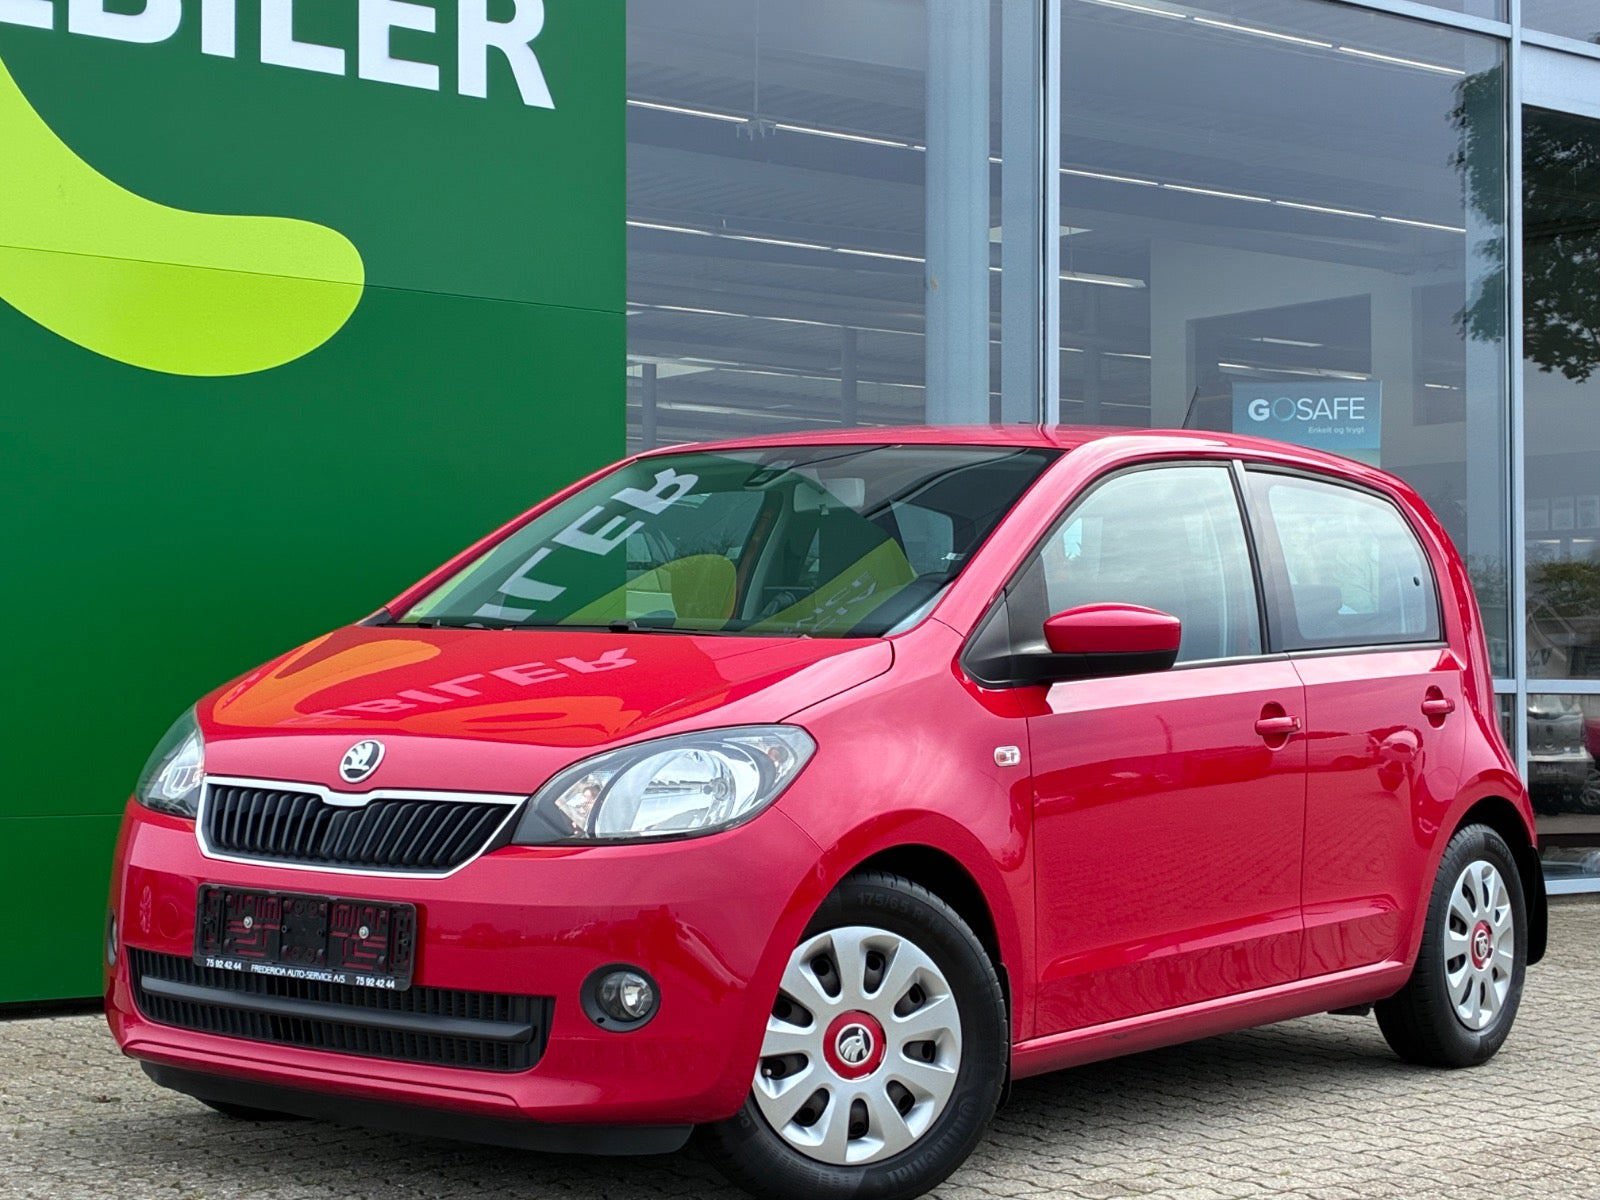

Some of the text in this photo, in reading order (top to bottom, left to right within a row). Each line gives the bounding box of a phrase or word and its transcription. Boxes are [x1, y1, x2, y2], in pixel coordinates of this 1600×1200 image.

[0, 0, 555, 109] LER
[1248, 397, 1365, 422] GOSAFE
[206, 958, 214, 968] 75
[233, 962, 242, 971] 44
[333, 974, 346, 984] A/S
[355, 976, 365, 986] 75
[365, 977, 375, 987] 92
[376, 979, 385, 988] 42
[386, 980, 395, 989] 44
